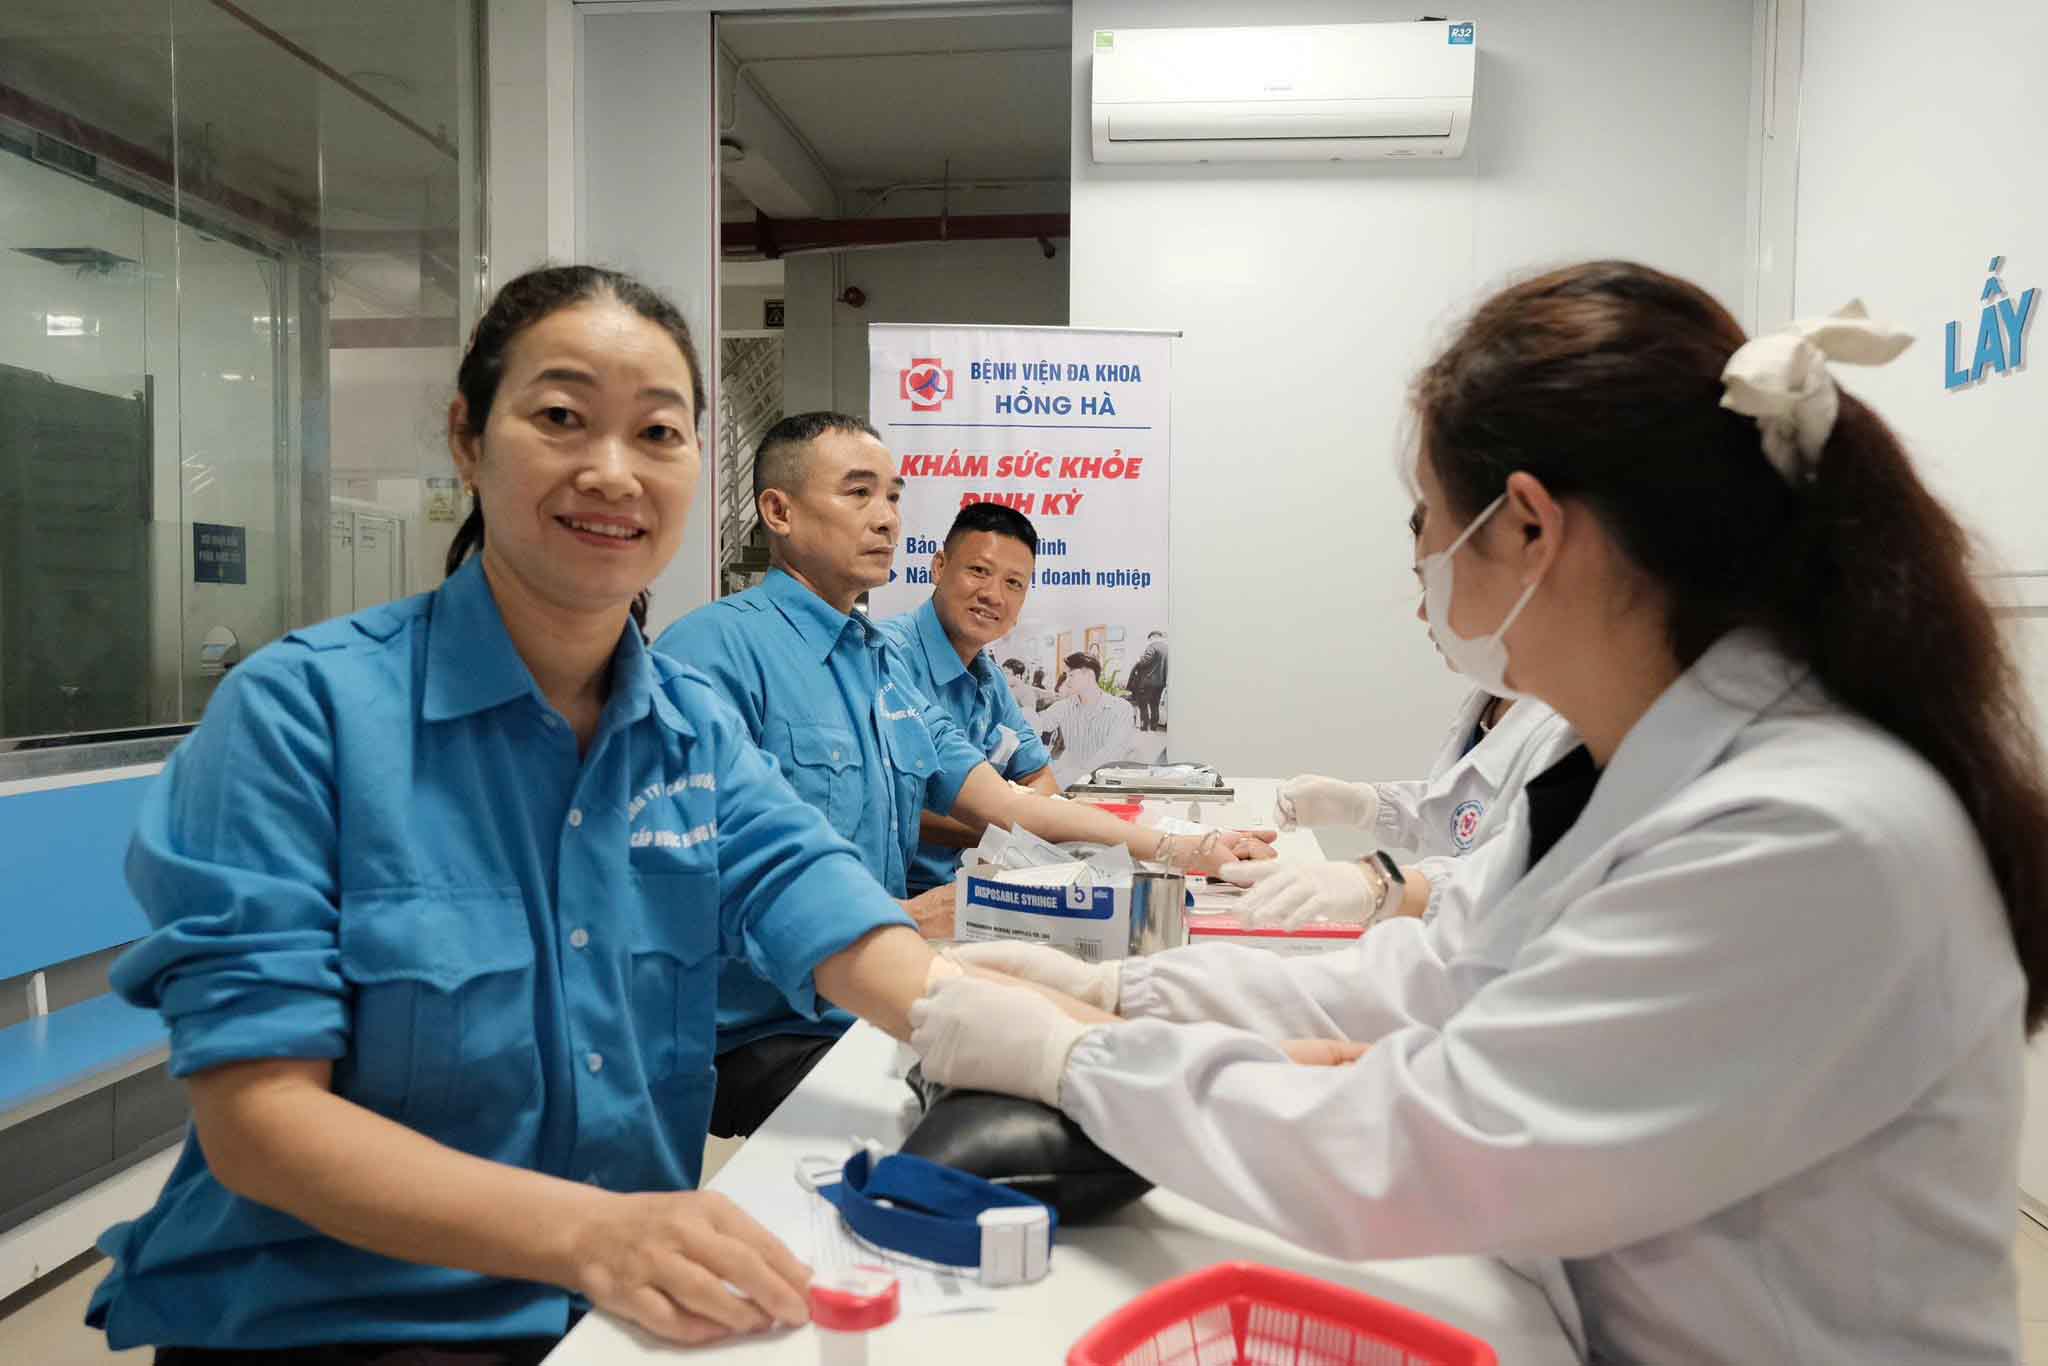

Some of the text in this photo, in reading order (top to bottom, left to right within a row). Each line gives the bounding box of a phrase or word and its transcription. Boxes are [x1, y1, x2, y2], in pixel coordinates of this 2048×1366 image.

[1450, 27, 1472, 38] R32
[1944, 256, 2035, 389] LẤY
[970, 358, 1142, 385] BỆNH VIỆN ĐA KHOA
[995, 385, 1116, 416] HỒNG HÀ
[899, 448, 1144, 480] KHÁM SỨC KHỎE
[906, 534, 937, 554] Bảo
[1041, 568, 1091, 585] doanh
[1096, 568, 1151, 590] nghiệp
[974, 885, 1020, 905] DISPOSABLE
[1021, 893, 1058, 909] SYRINGE
[1073, 880, 1086, 904] 5
